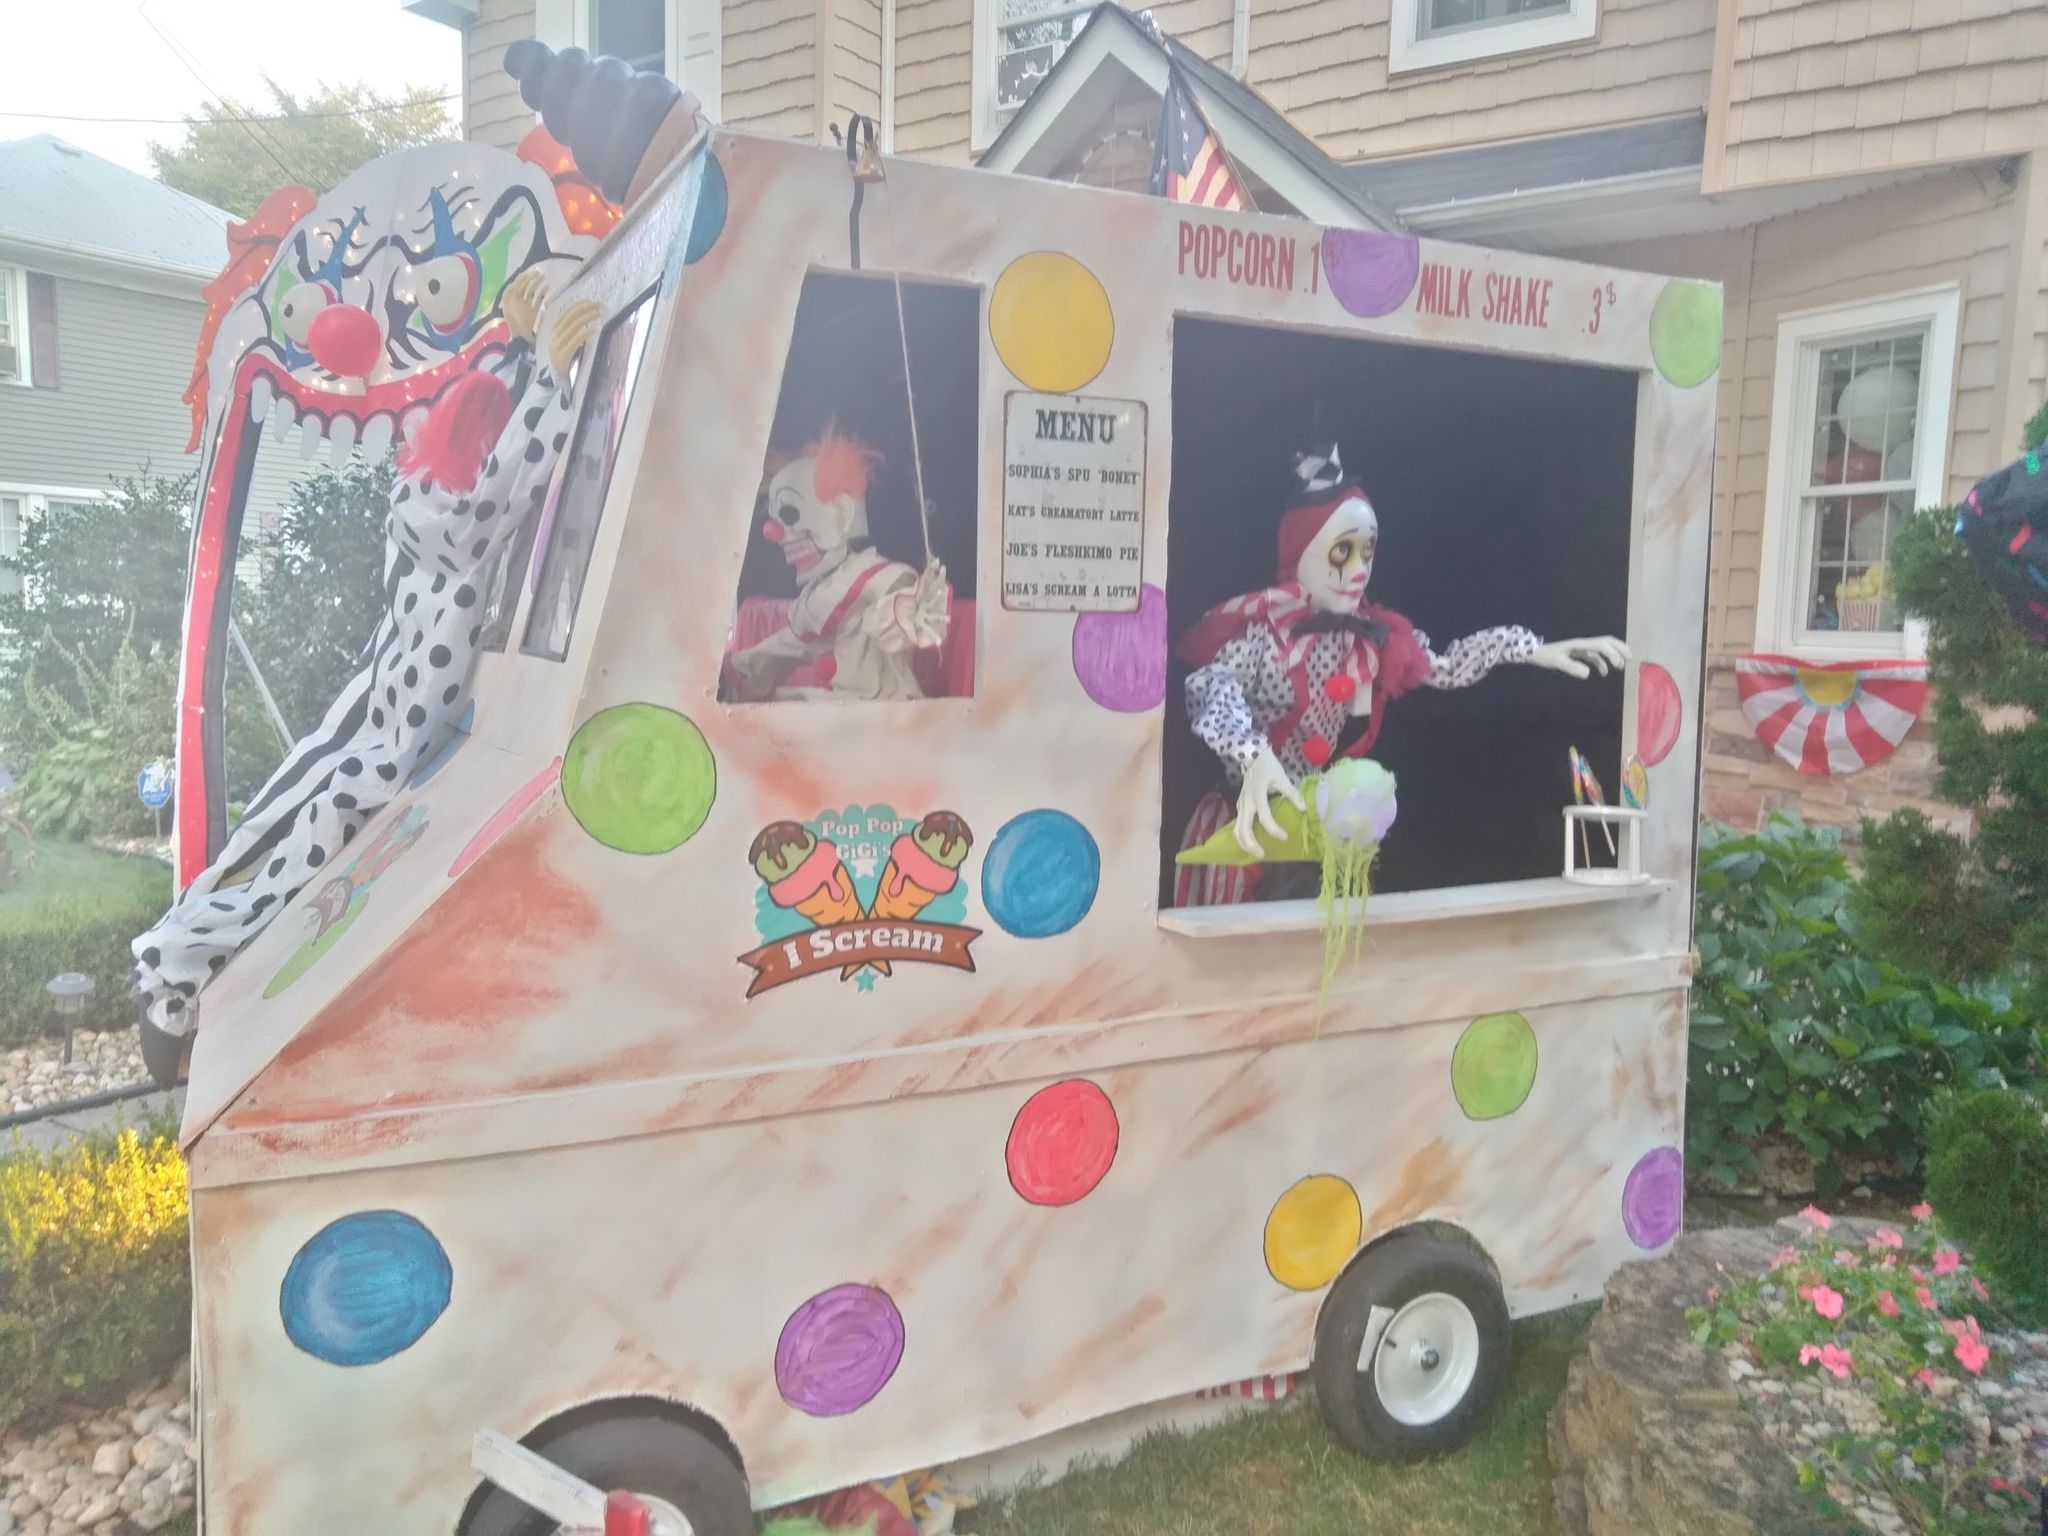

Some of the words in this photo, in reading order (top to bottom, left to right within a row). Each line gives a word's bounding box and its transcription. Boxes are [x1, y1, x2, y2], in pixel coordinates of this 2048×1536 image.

[1178, 219, 1296, 291] POPCORN
[1415, 263, 1473, 319] MILK
[1481, 270, 1554, 329] SHAKE
[1034, 408, 1117, 444] MENU
[1008, 464, 1061, 480] SOPHIA'S
[1067, 467, 1091, 481] SPU
[1007, 503, 1036, 518] KAT'S
[1041, 505, 1105, 521] CREAMATORY
[1109, 509, 1140, 523] LATTE
[1006, 542, 1039, 558] JOE'S
[1045, 544, 1113, 560] FLESHKIMO
[1119, 546, 1139, 562] PIE
[1005, 582, 1039, 596] LISA'S
[1044, 583, 1087, 598] SCREAM
[1093, 584, 1100, 598] A
[1106, 585, 1137, 599] LOTTA
[822, 820, 860, 839] Pop
[866, 817, 904, 836] Pop
[782, 941, 803, 969] I
[809, 926, 945, 959] Scream
